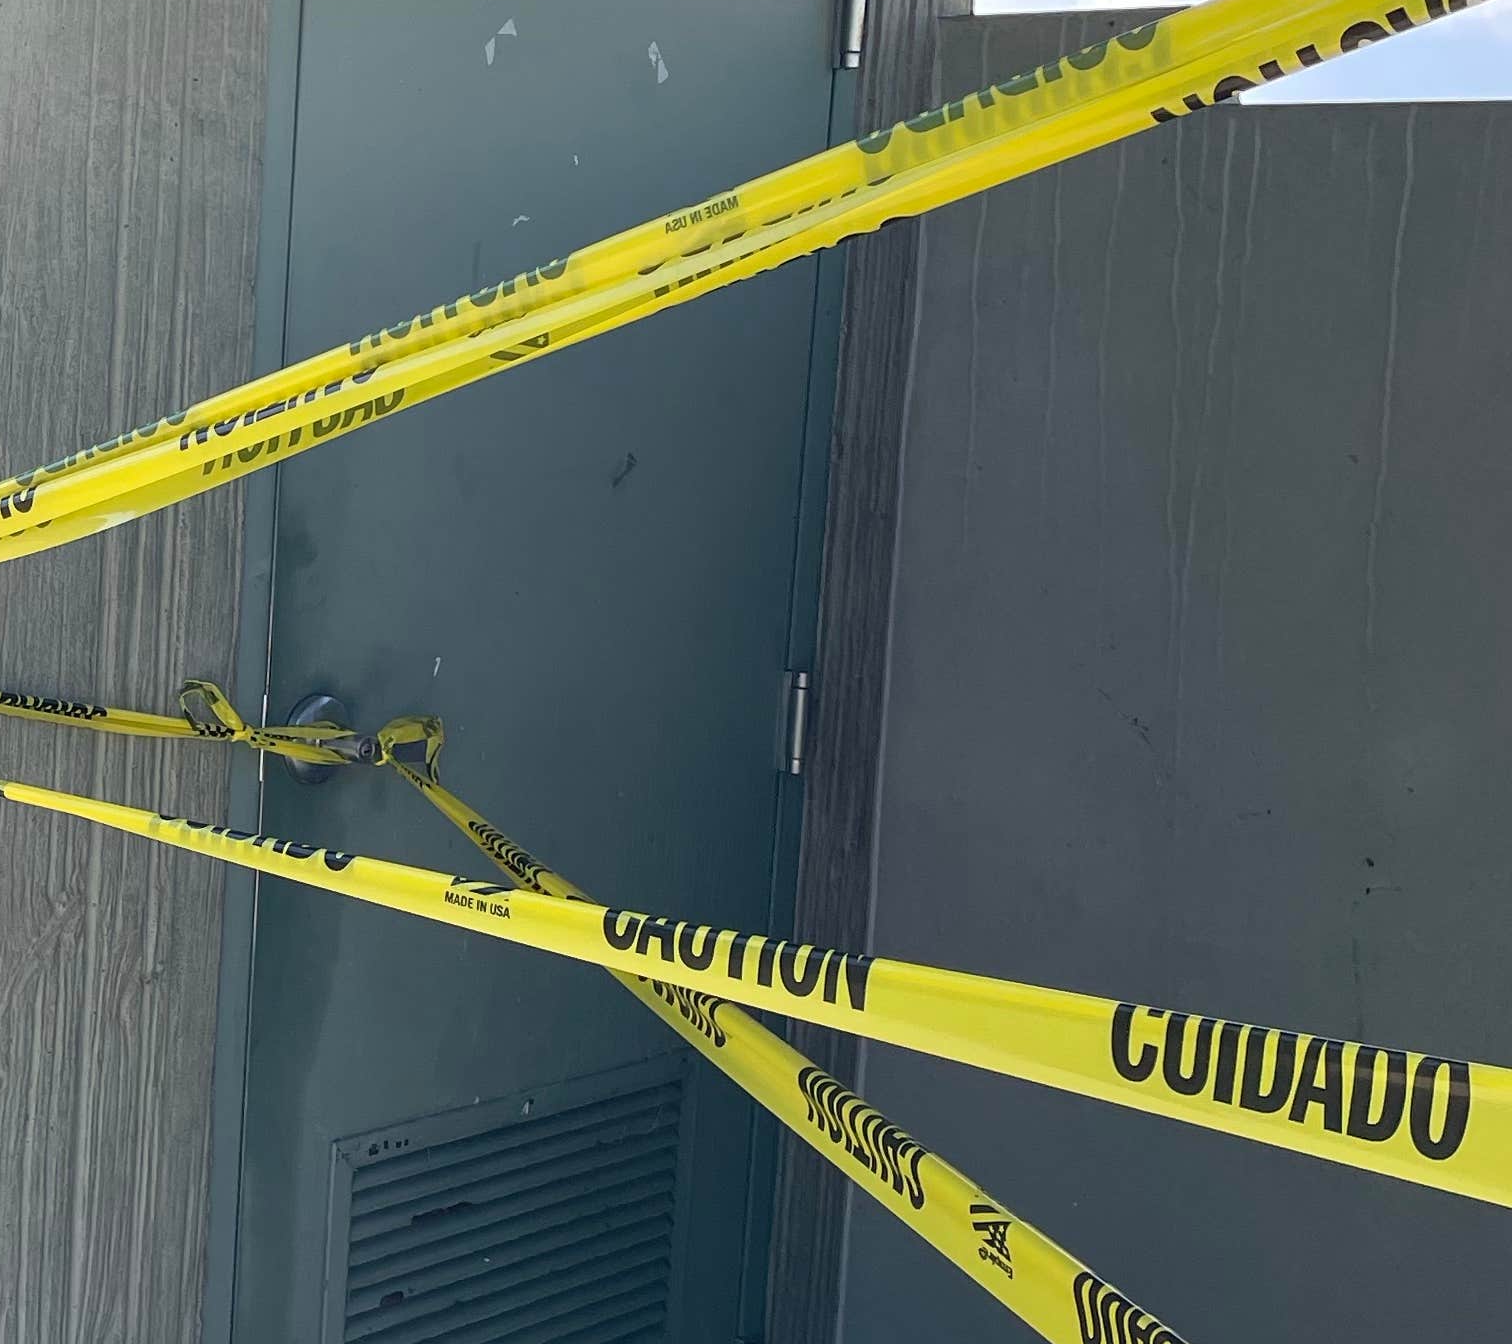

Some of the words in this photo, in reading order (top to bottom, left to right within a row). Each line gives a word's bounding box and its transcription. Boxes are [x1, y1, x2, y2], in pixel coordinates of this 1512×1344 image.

[444, 891, 474, 910] MADE
[476, 900, 487, 913] IN
[489, 903, 510, 919] USA
[602, 907, 875, 1012] CAUTION
[1109, 1003, 1471, 1161] CUIDADO
[797, 1066, 928, 1211] CAUTION
